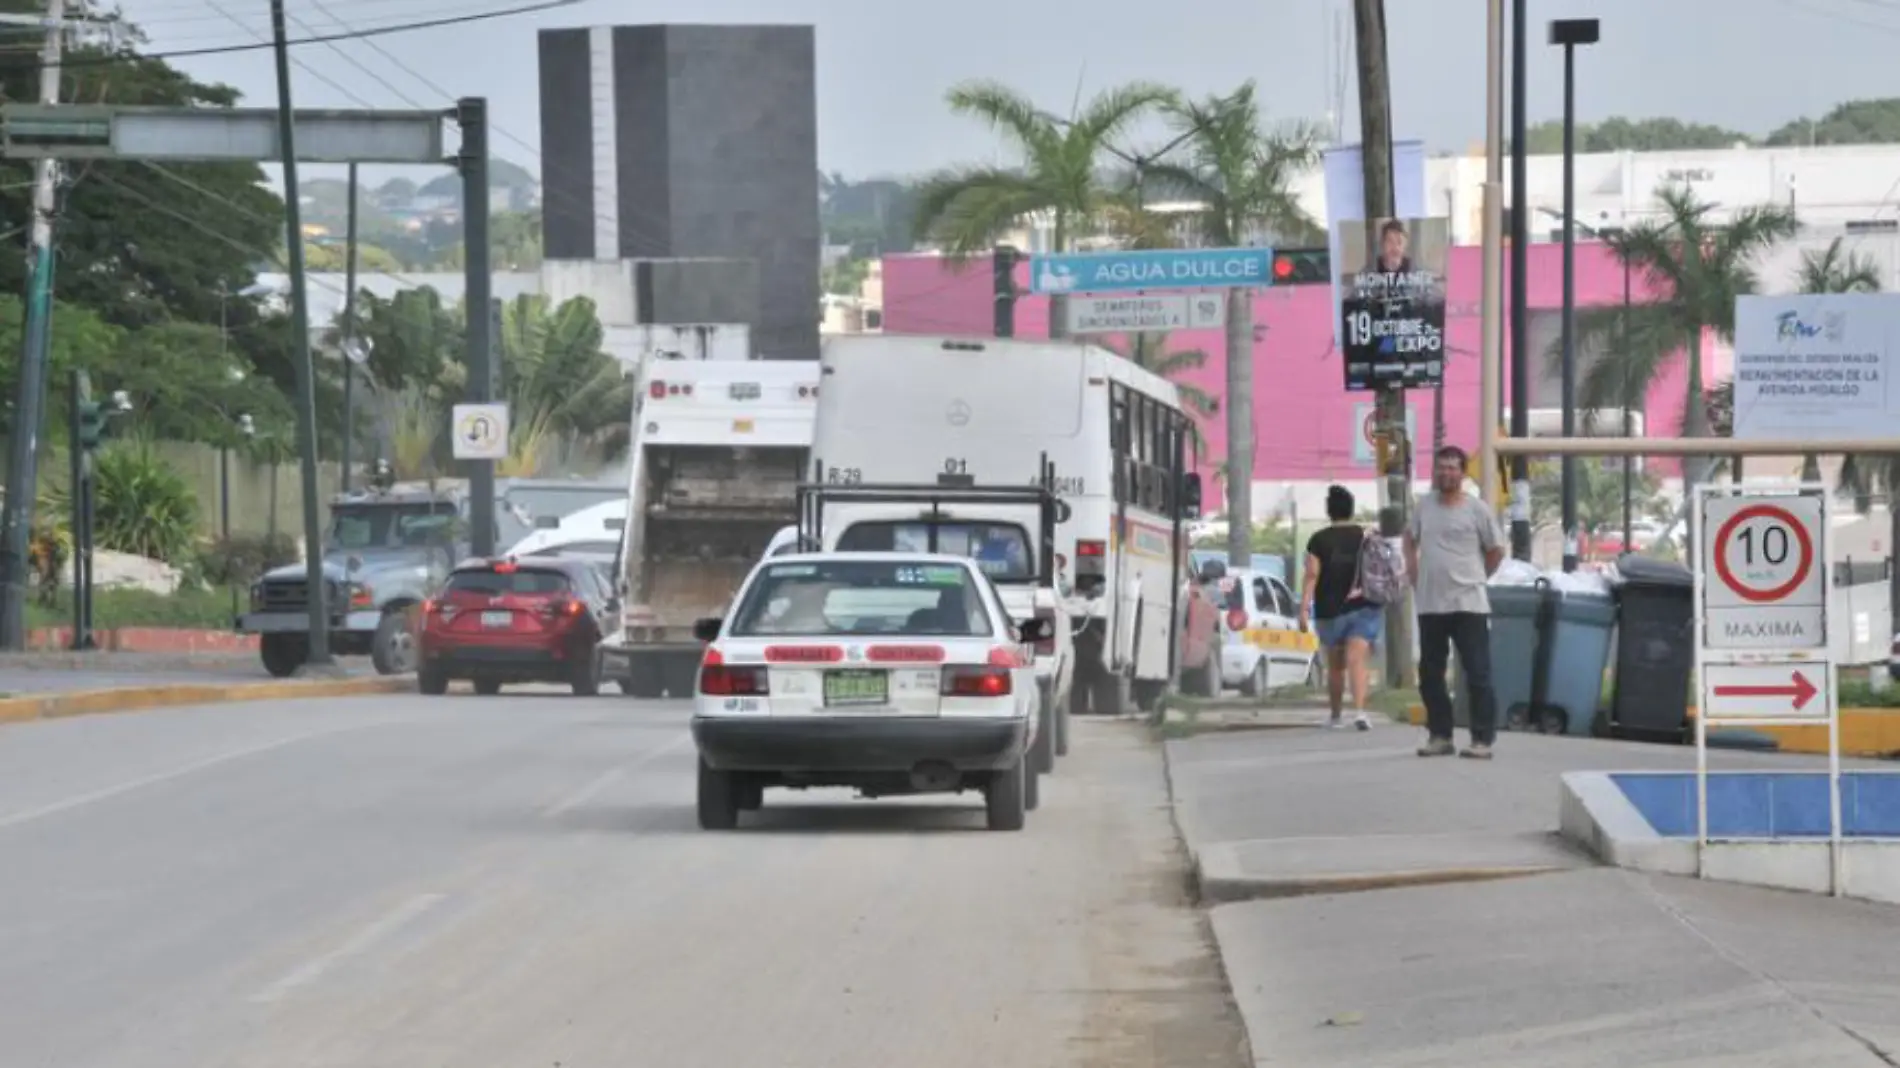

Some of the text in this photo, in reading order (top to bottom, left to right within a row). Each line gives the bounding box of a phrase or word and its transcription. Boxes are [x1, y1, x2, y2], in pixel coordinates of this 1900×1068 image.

[1095, 257, 1260, 282] AGUA DULCE
[1346, 311, 1371, 345] 19
[1395, 335, 1441, 352] EXPO
[1737, 525, 1788, 565] 10
[1725, 622, 1804, 637] MAXIMA
